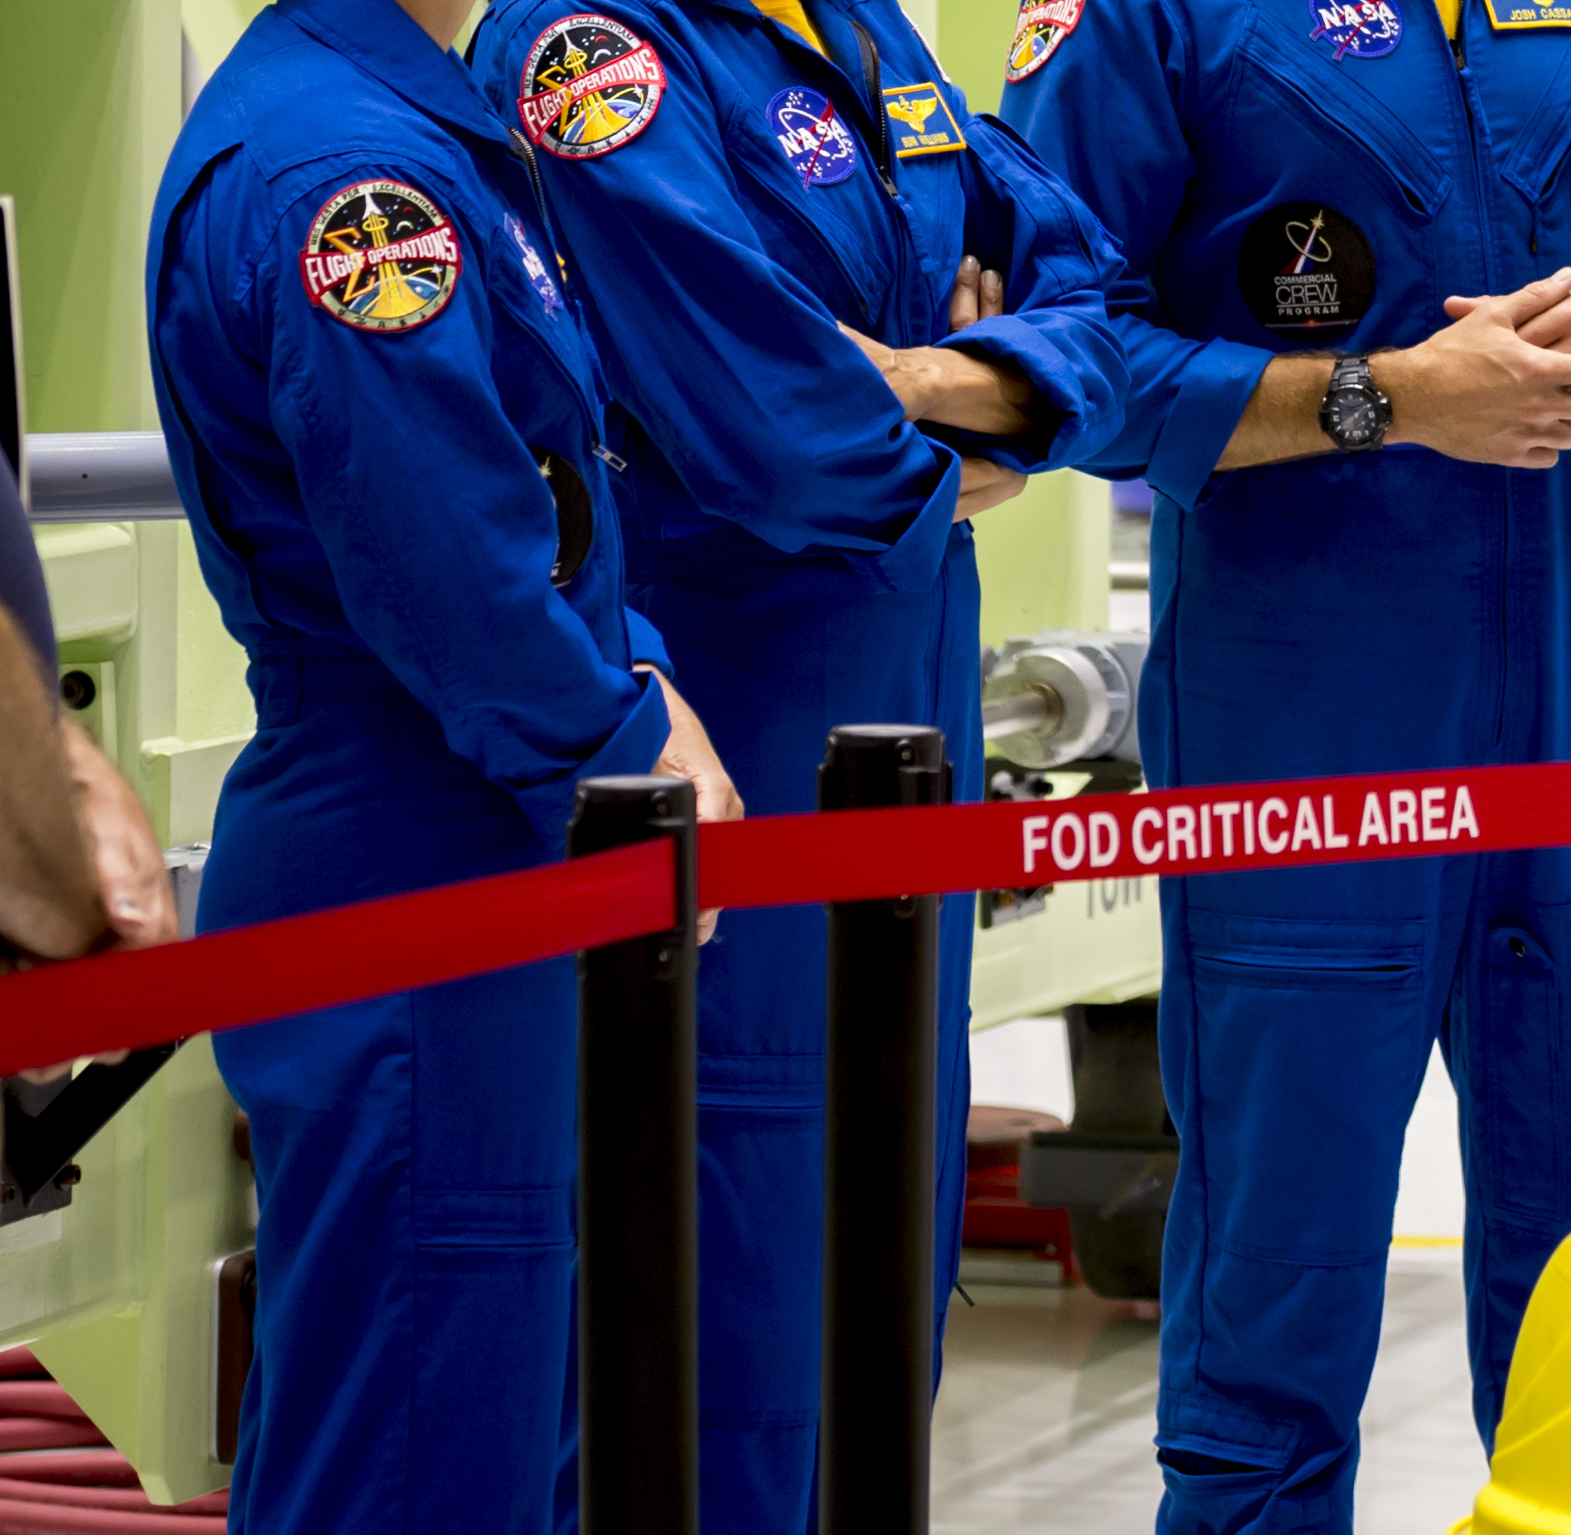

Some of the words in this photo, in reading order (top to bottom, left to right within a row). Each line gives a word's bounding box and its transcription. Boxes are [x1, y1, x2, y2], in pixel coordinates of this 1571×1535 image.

[1317, 2, 1397, 30] NASA
[1510, 9, 1535, 21] JOSH
[522, 88, 571, 137] FLIGHT
[571, 49, 660, 96] OPERATIONS
[778, 117, 848, 157] NASA
[305, 251, 366, 295] FLIGHT
[367, 227, 457, 264] OPERATIONS
[1274, 273, 1337, 285] COMMERCIAL
[1275, 283, 1338, 305] CREW
[1278, 306, 1339, 316] PROGRAM
[1022, 811, 1121, 874] FOD
[1132, 794, 1348, 865] CRITICAL
[1358, 785, 1481, 846] AREA
